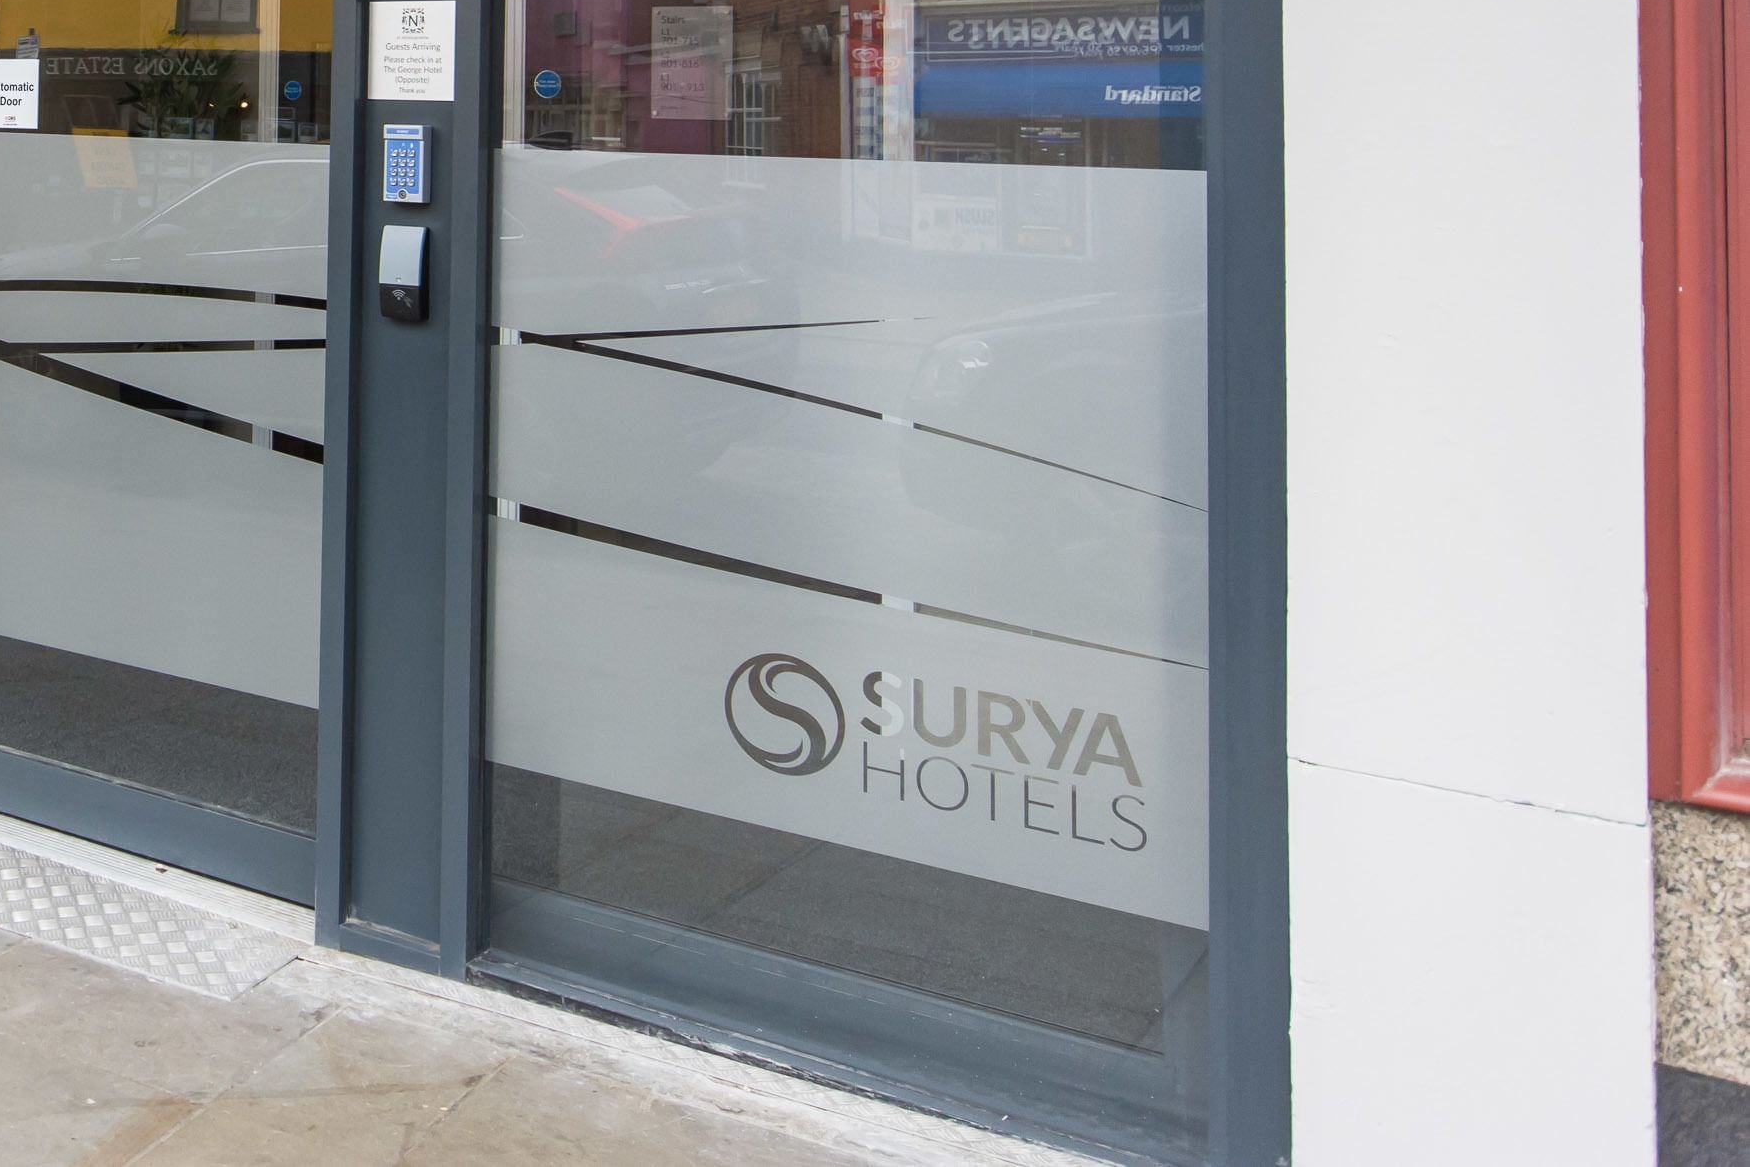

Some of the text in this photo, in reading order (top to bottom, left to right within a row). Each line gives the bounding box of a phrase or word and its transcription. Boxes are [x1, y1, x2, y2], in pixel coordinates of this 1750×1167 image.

[386, 43, 441, 52] Guests Arriving
[397, 66, 422, 75] George
[395, 75, 430, 85] (Opposite)
[0, 96, 22, 106] Door
[860, 670, 1144, 788] SURYA
[862, 741, 1148, 852] HOTELS
